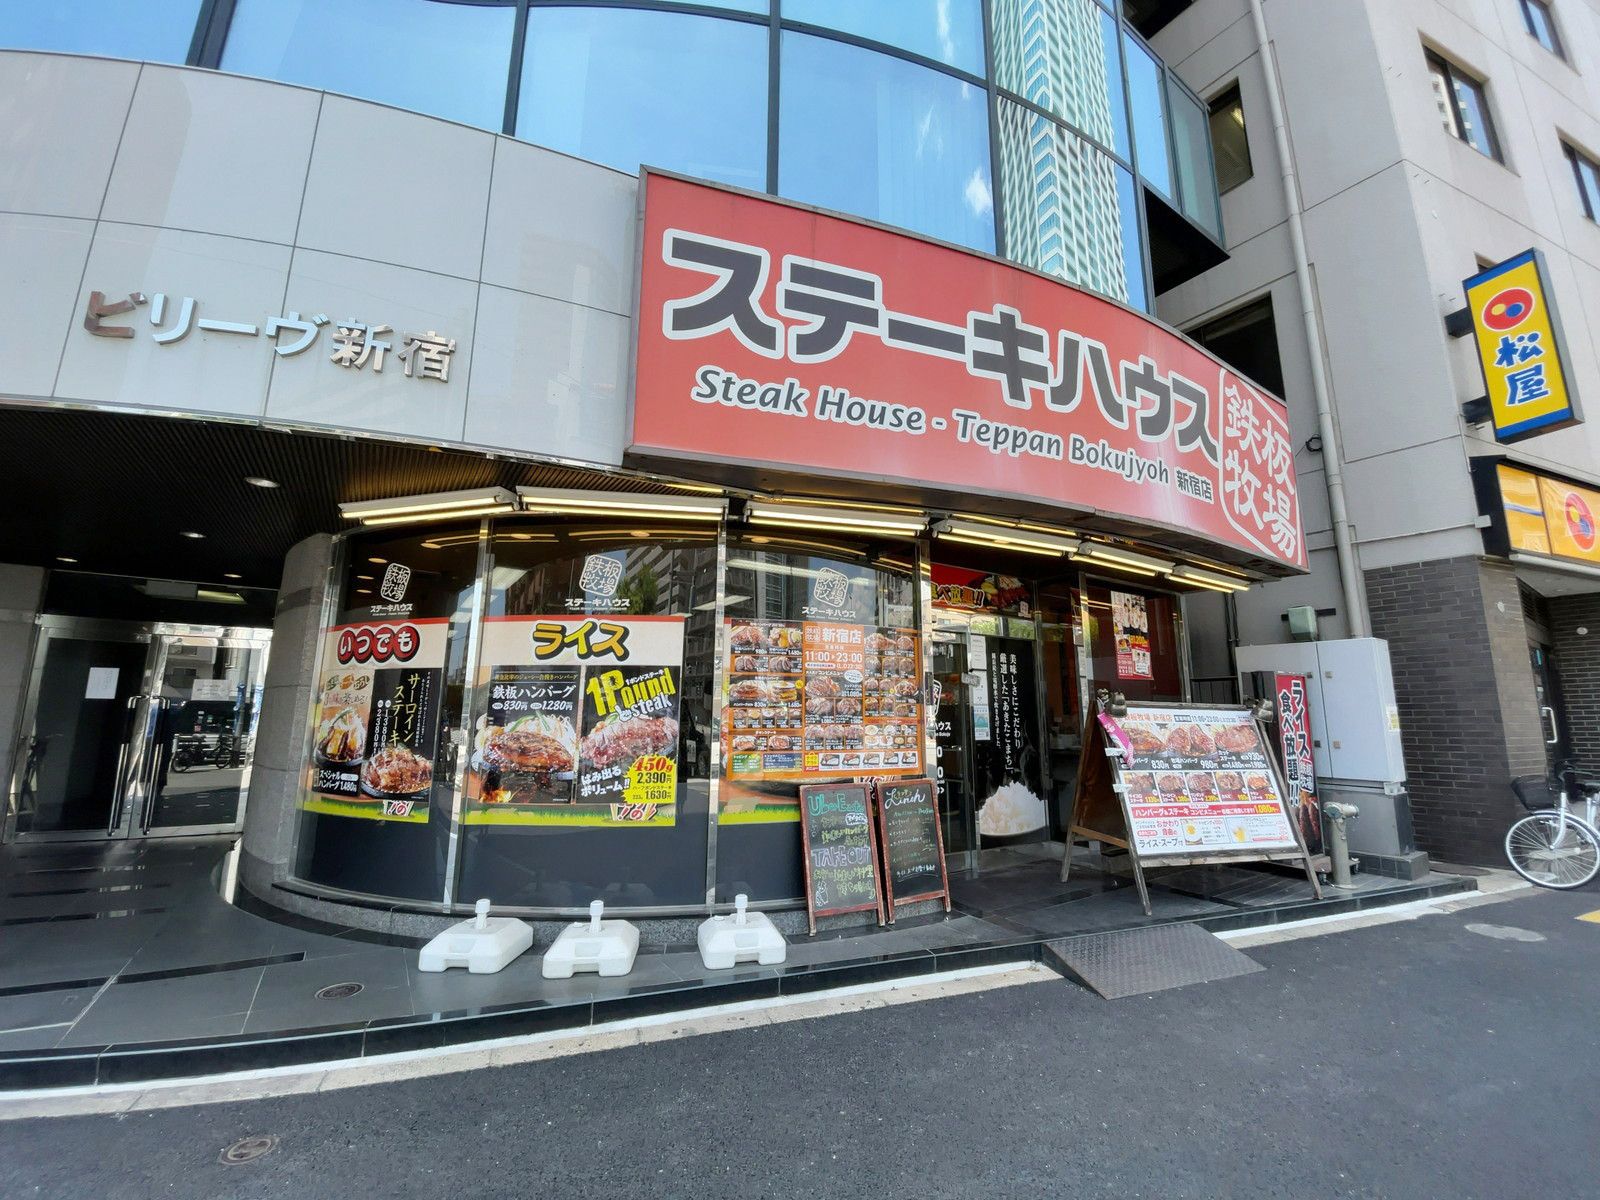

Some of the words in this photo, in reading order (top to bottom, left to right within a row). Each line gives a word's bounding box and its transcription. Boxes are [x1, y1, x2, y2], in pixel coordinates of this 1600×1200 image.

[83, 290, 458, 384] ビリーヴ新宿
[665, 231, 1219, 464] ステーキハウス
[1494, 331, 1550, 407] 松屋
[697, 368, 805, 414] Steak
[818, 388, 924, 432] House
[957, 411, 1063, 459] Teppan
[1070, 438, 1171, 485] Bokujyoh
[1176, 470, 1212, 501] 新宿店
[370, 603, 413, 613] ステーキハウス
[565, 598, 630, 607] ステーキハウス
[801, 606, 856, 618] ステーキハウス
[340, 630, 414, 656] いつでも
[533, 621, 630, 662] ライス
[822, 628, 861, 644] 新宿店
[805, 651, 830, 661] 11:00
[836, 652, 863, 663] 23:00
[626, 669, 664, 686] 1ポンドステーキ
[493, 684, 577, 699] 鉄板ハンバーグ
[403, 673, 420, 742] サーロイン
[503, 700, 528, 710] 830円
[633, 692, 673, 717] steak
[1009, 654, 1021, 749] 美味しさにこだわり
[388, 685, 404, 747] ステーキ
[1292, 681, 1310, 759] ライス
[633, 757, 673, 772] 450g
[1151, 759, 1170, 769] 830円
[1200, 760, 1219, 769] 980円
[319, 769, 341, 780] スペシャル
[581, 766, 622, 785] はみ出る
[319, 780, 341, 790] ハンバーグ
[1156, 820, 1179, 828] おかわり
